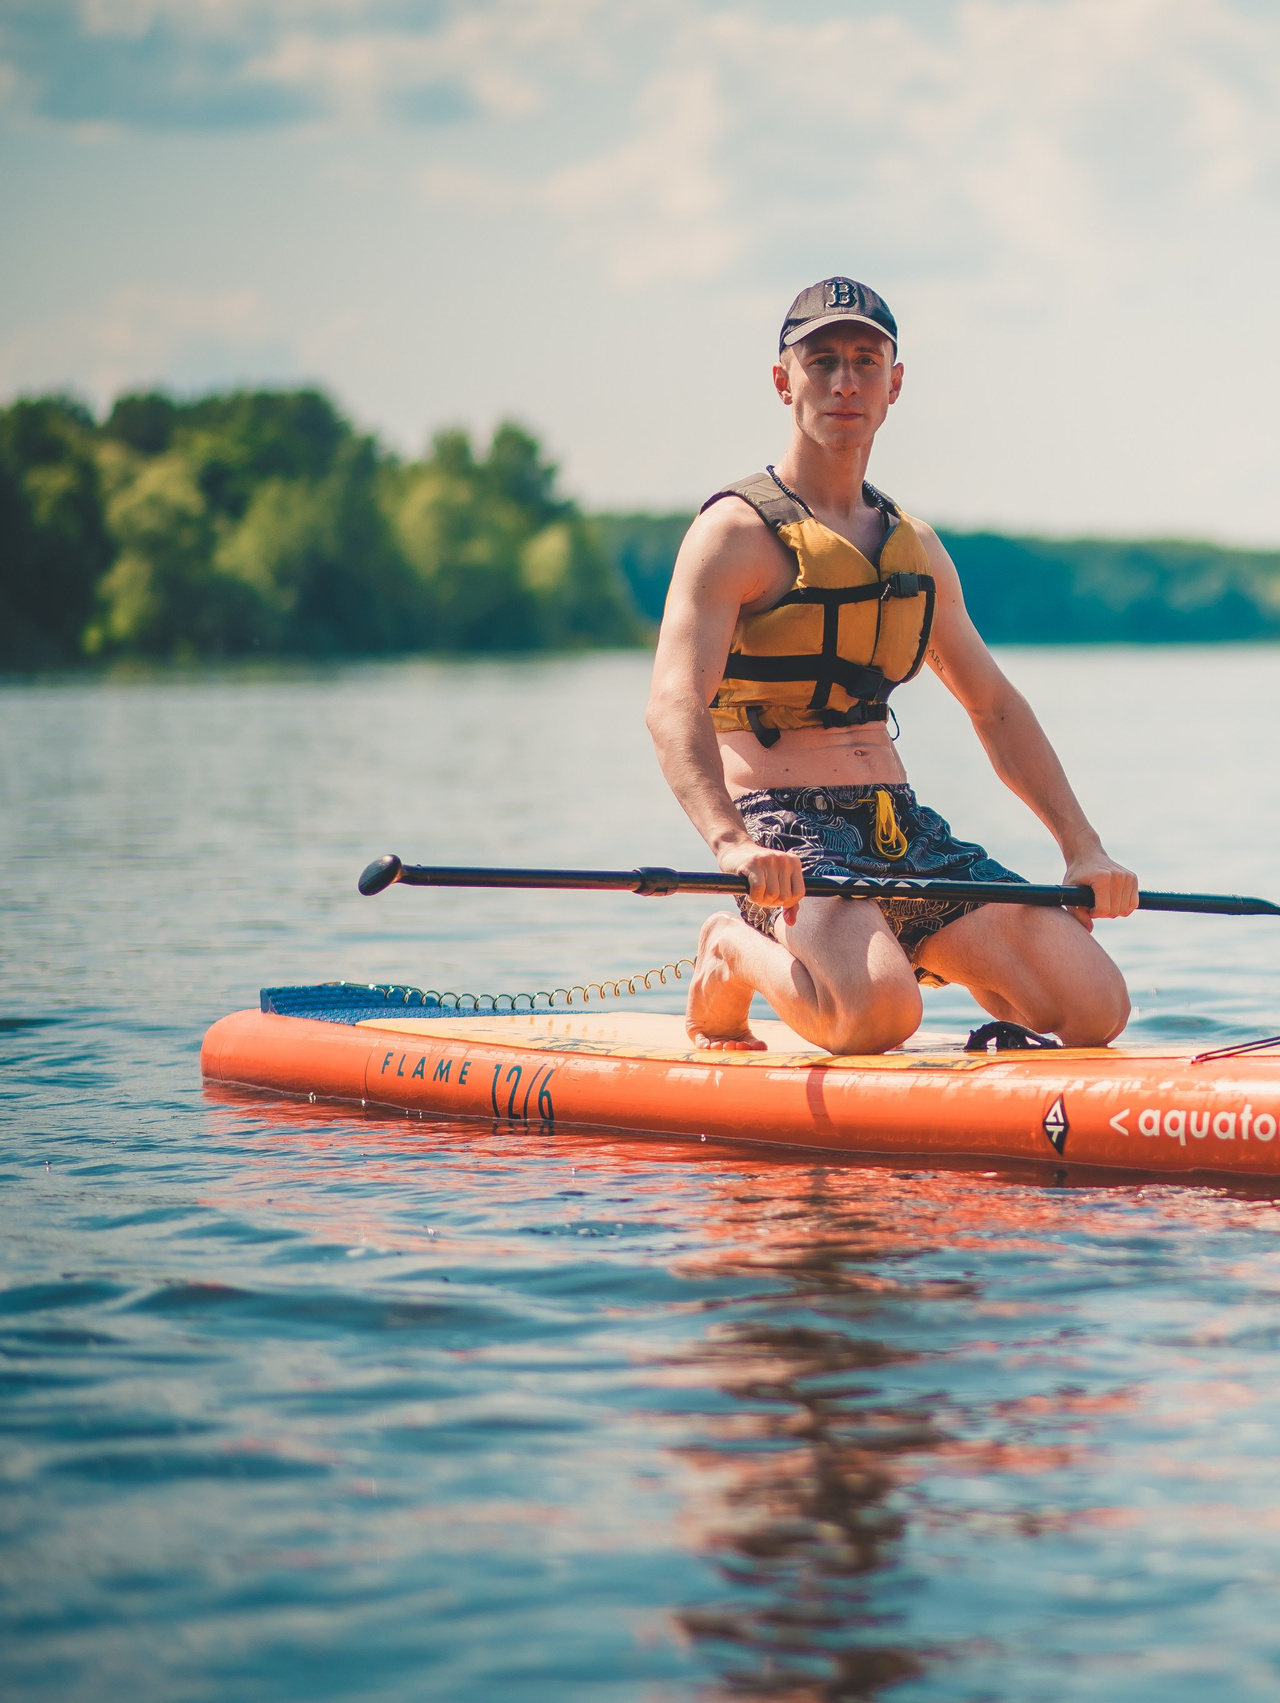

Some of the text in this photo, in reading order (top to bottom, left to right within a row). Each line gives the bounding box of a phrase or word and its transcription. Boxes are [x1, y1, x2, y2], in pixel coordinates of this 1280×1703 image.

[825, 281, 857, 308] B
[381, 1052, 556, 1121] FLAME 12/6
